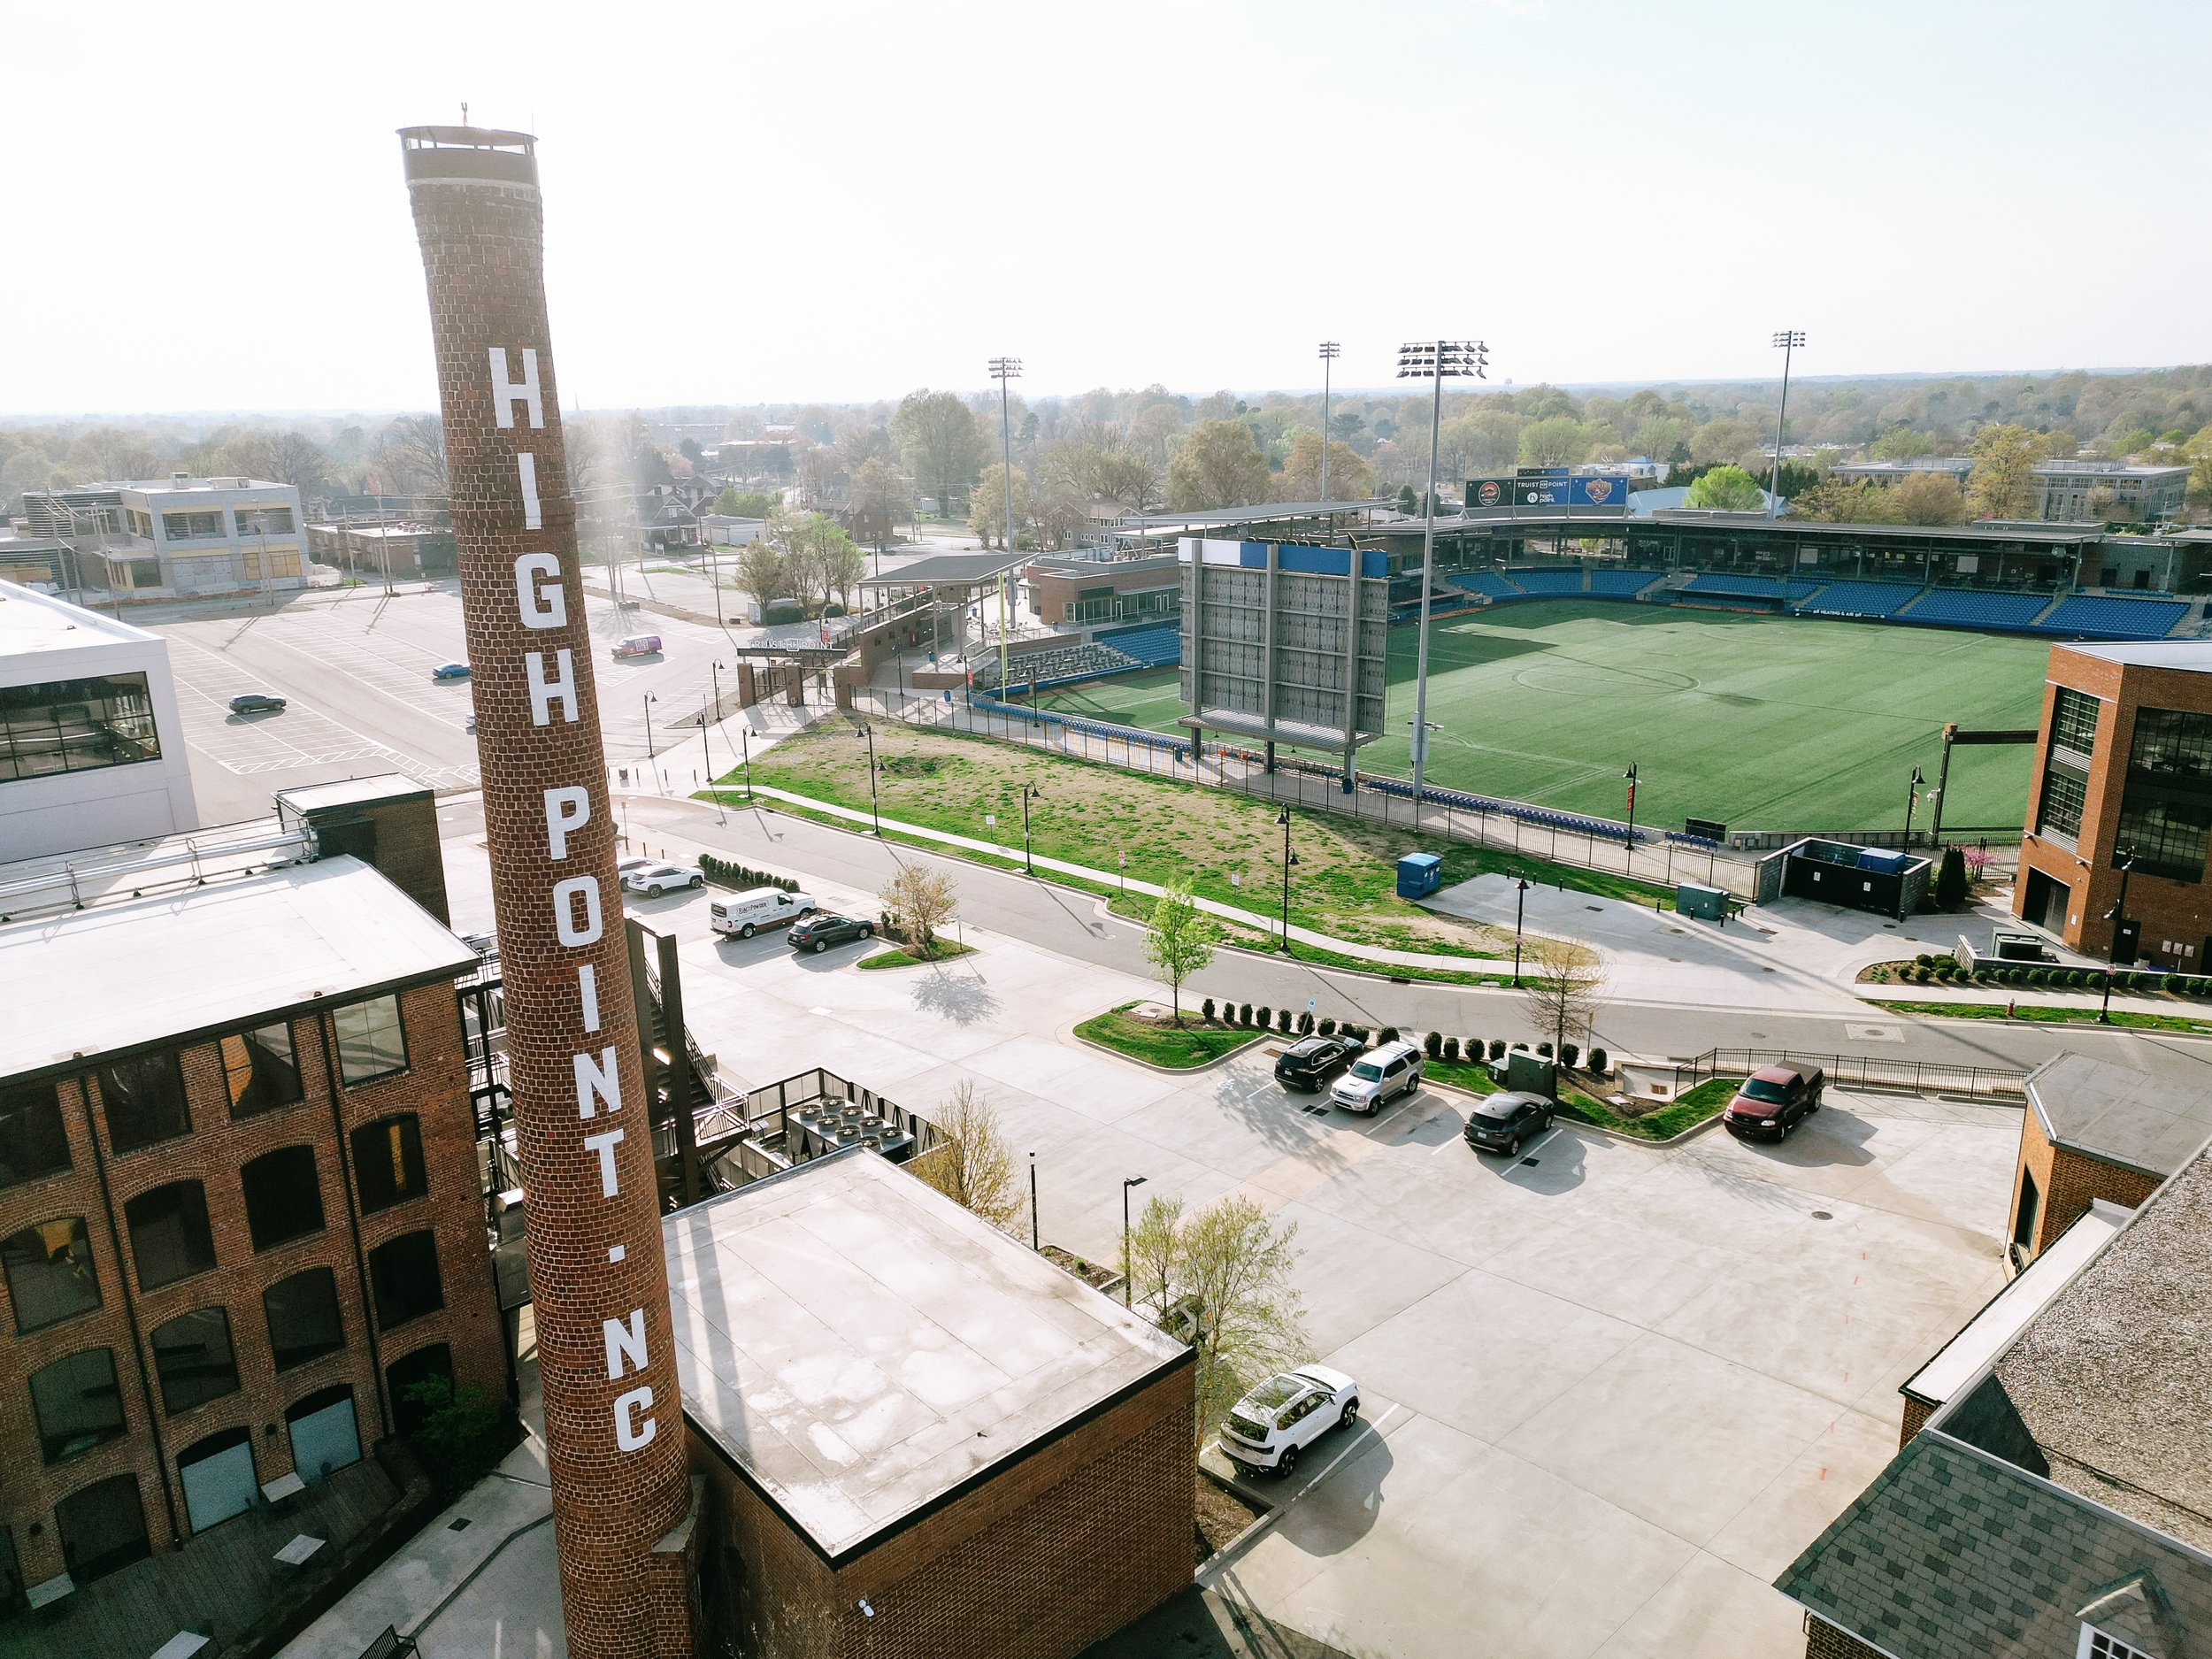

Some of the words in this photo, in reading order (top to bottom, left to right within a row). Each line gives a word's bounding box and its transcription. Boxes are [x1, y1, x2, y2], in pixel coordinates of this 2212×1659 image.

[488, 347, 579, 726] HIGH
[543, 786, 625, 1199] POINT
[603, 1309, 657, 1452] NC
[749, 639, 784, 649] TRUIST
[802, 641, 834, 650] POINT
